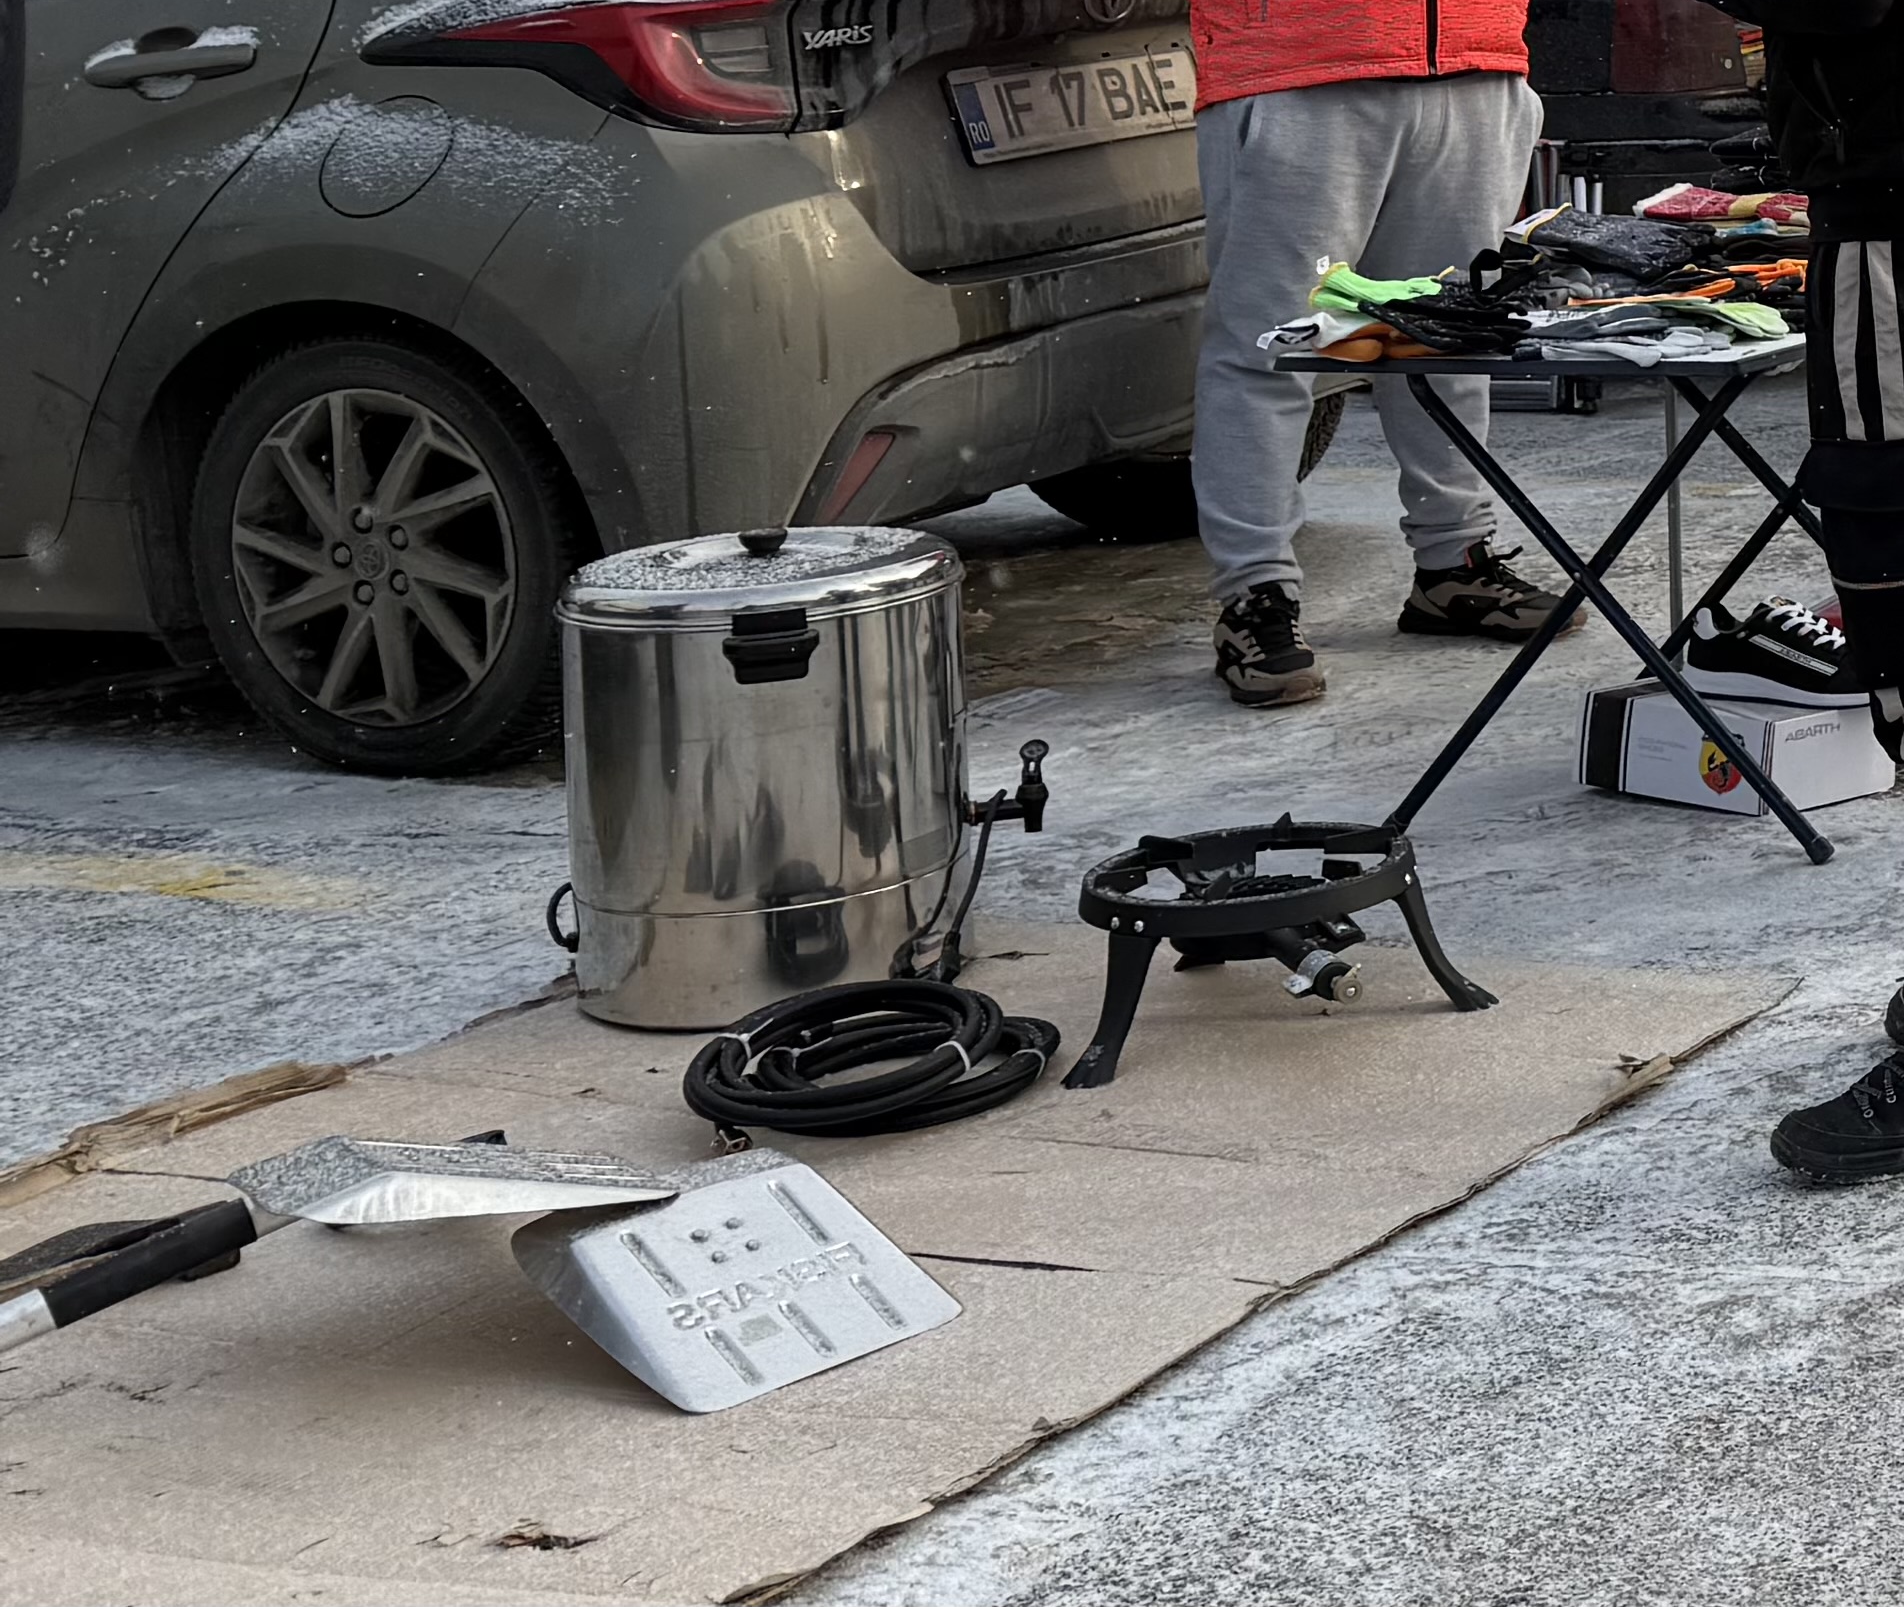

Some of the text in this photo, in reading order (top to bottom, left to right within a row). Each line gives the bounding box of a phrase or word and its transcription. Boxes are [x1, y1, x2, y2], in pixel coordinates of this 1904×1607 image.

[994, 58, 1188, 139] IF 17 BAE
[968, 121, 991, 144] RO
[1784, 721, 1841, 743] ABARTH
